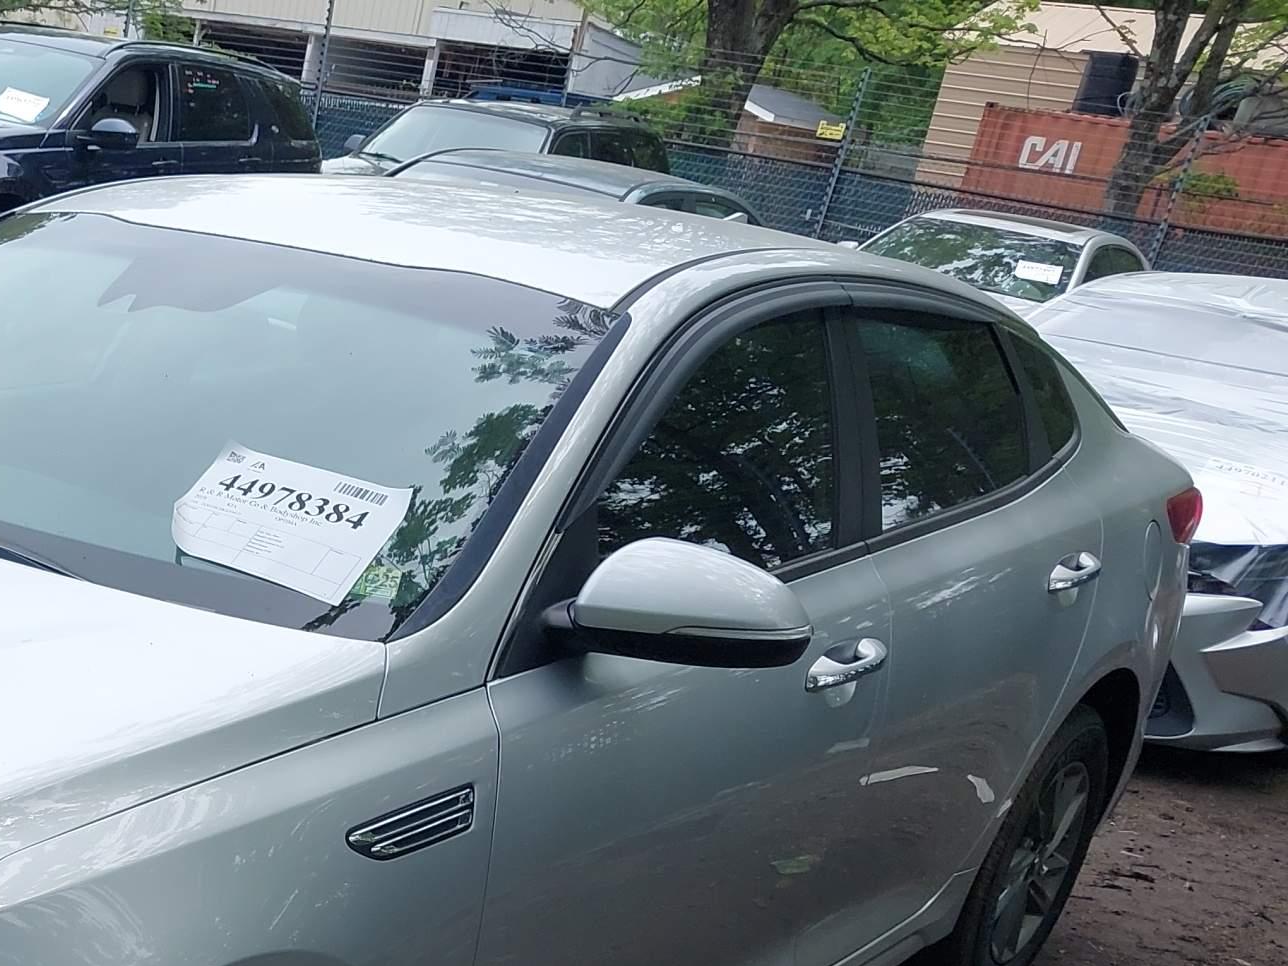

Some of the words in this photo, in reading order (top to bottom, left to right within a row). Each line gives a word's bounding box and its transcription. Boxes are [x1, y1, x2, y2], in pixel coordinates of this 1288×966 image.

[1018, 135, 1083, 175] CAI
[218, 474, 370, 530] 44978384
[225, 492, 250, 505] Motor
[249, 500, 260, 508] Co
[270, 505, 309, 522] Bodyshop
[308, 517, 323, 527] Inc
